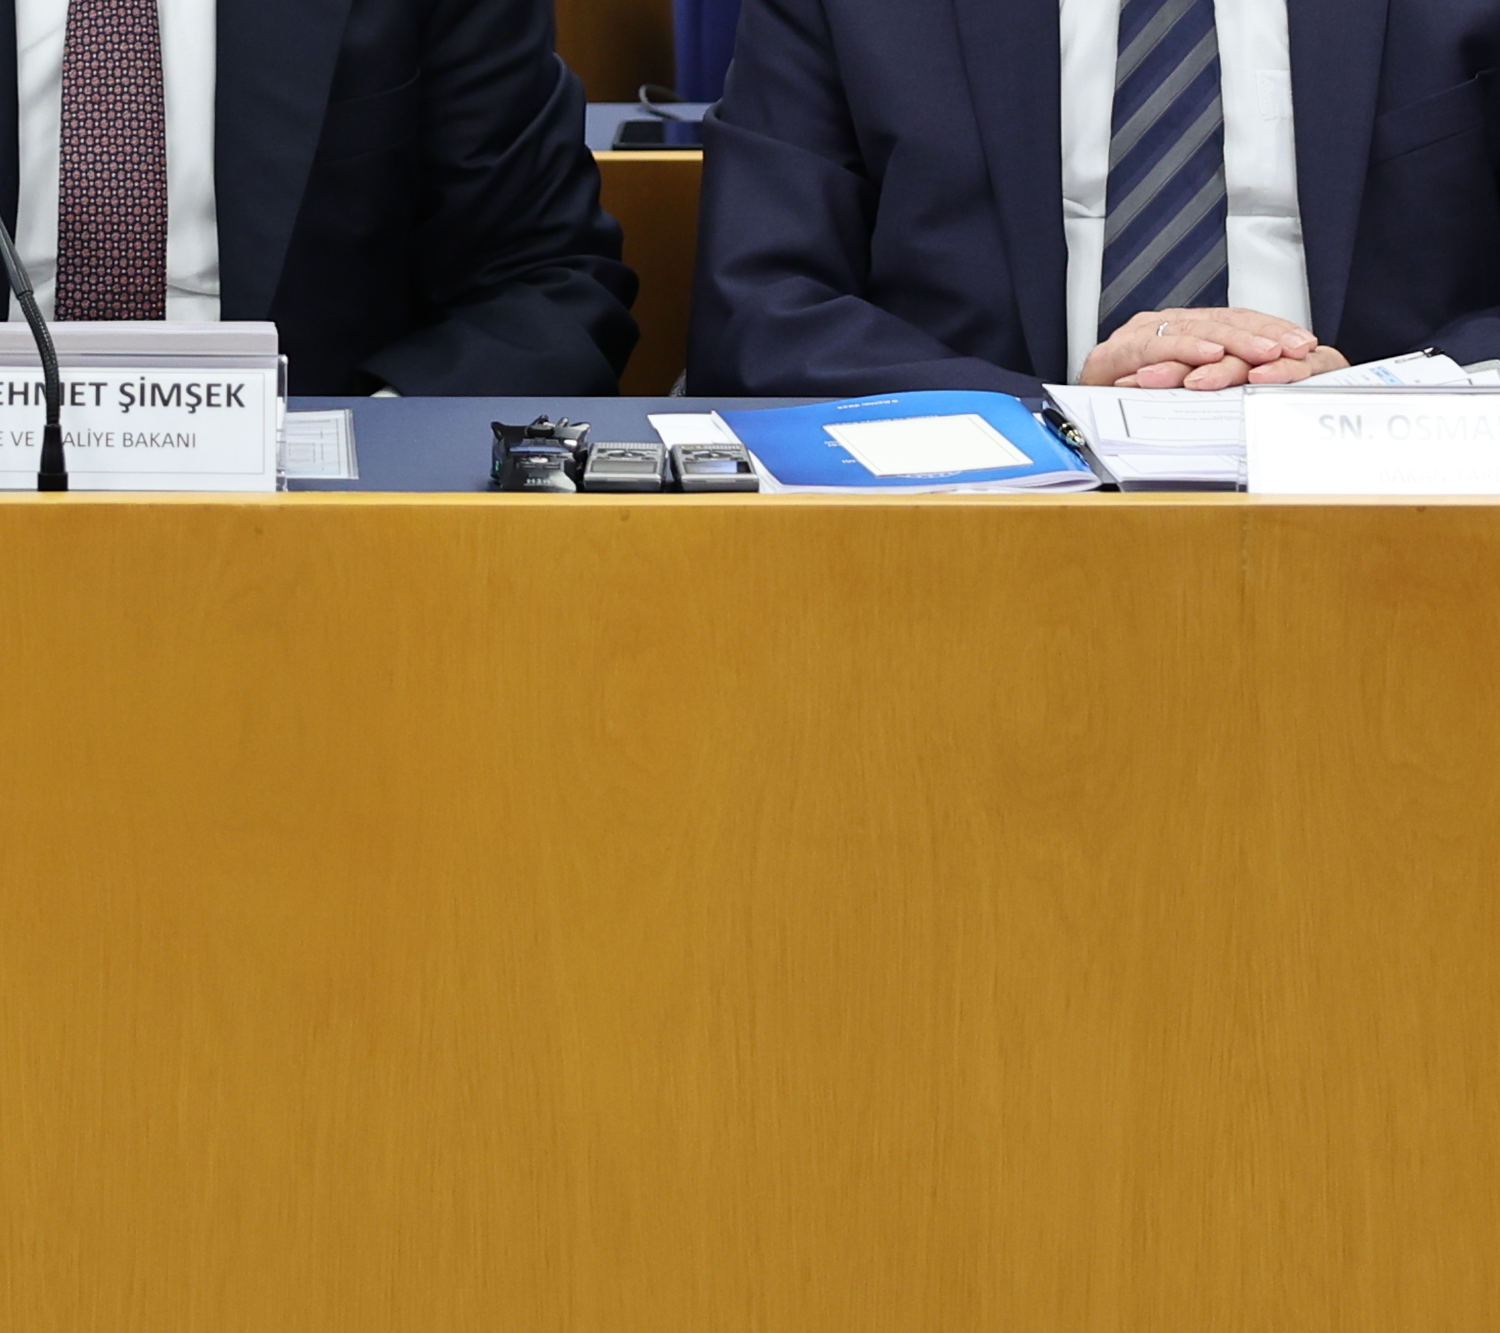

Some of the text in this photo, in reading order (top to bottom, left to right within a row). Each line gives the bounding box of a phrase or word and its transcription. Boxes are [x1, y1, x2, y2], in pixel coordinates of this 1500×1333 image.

[118, 376, 246, 414] ŞİMŞEK
[10, 430, 35, 447] VE
[53, 428, 115, 449] ALİYE
[122, 431, 197, 449] BAKANI
[1318, 413, 1374, 441] SN.
